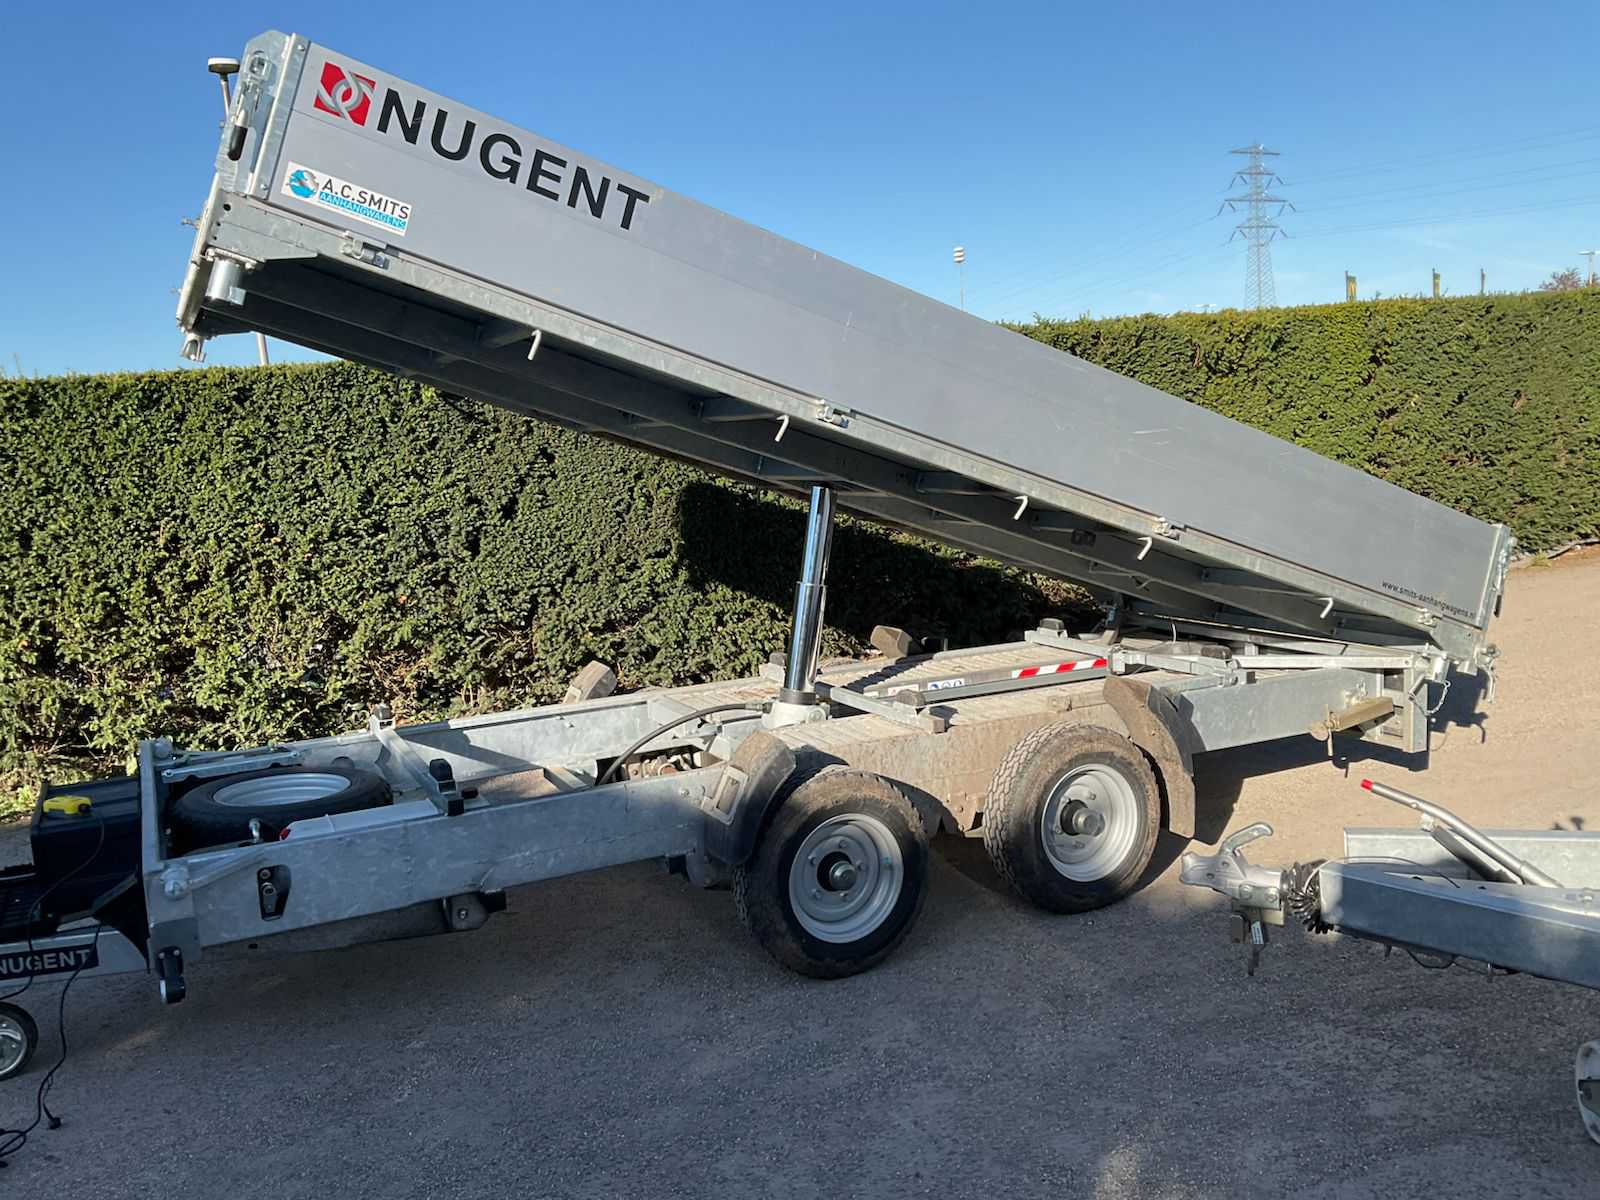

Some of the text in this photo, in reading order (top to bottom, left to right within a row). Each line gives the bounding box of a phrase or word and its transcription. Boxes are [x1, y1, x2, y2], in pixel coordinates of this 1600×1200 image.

[376, 87, 650, 231] NUGENT
[320, 193, 407, 230] AANHANGWAGENS
[322, 178, 410, 219] A.C.SMITS
